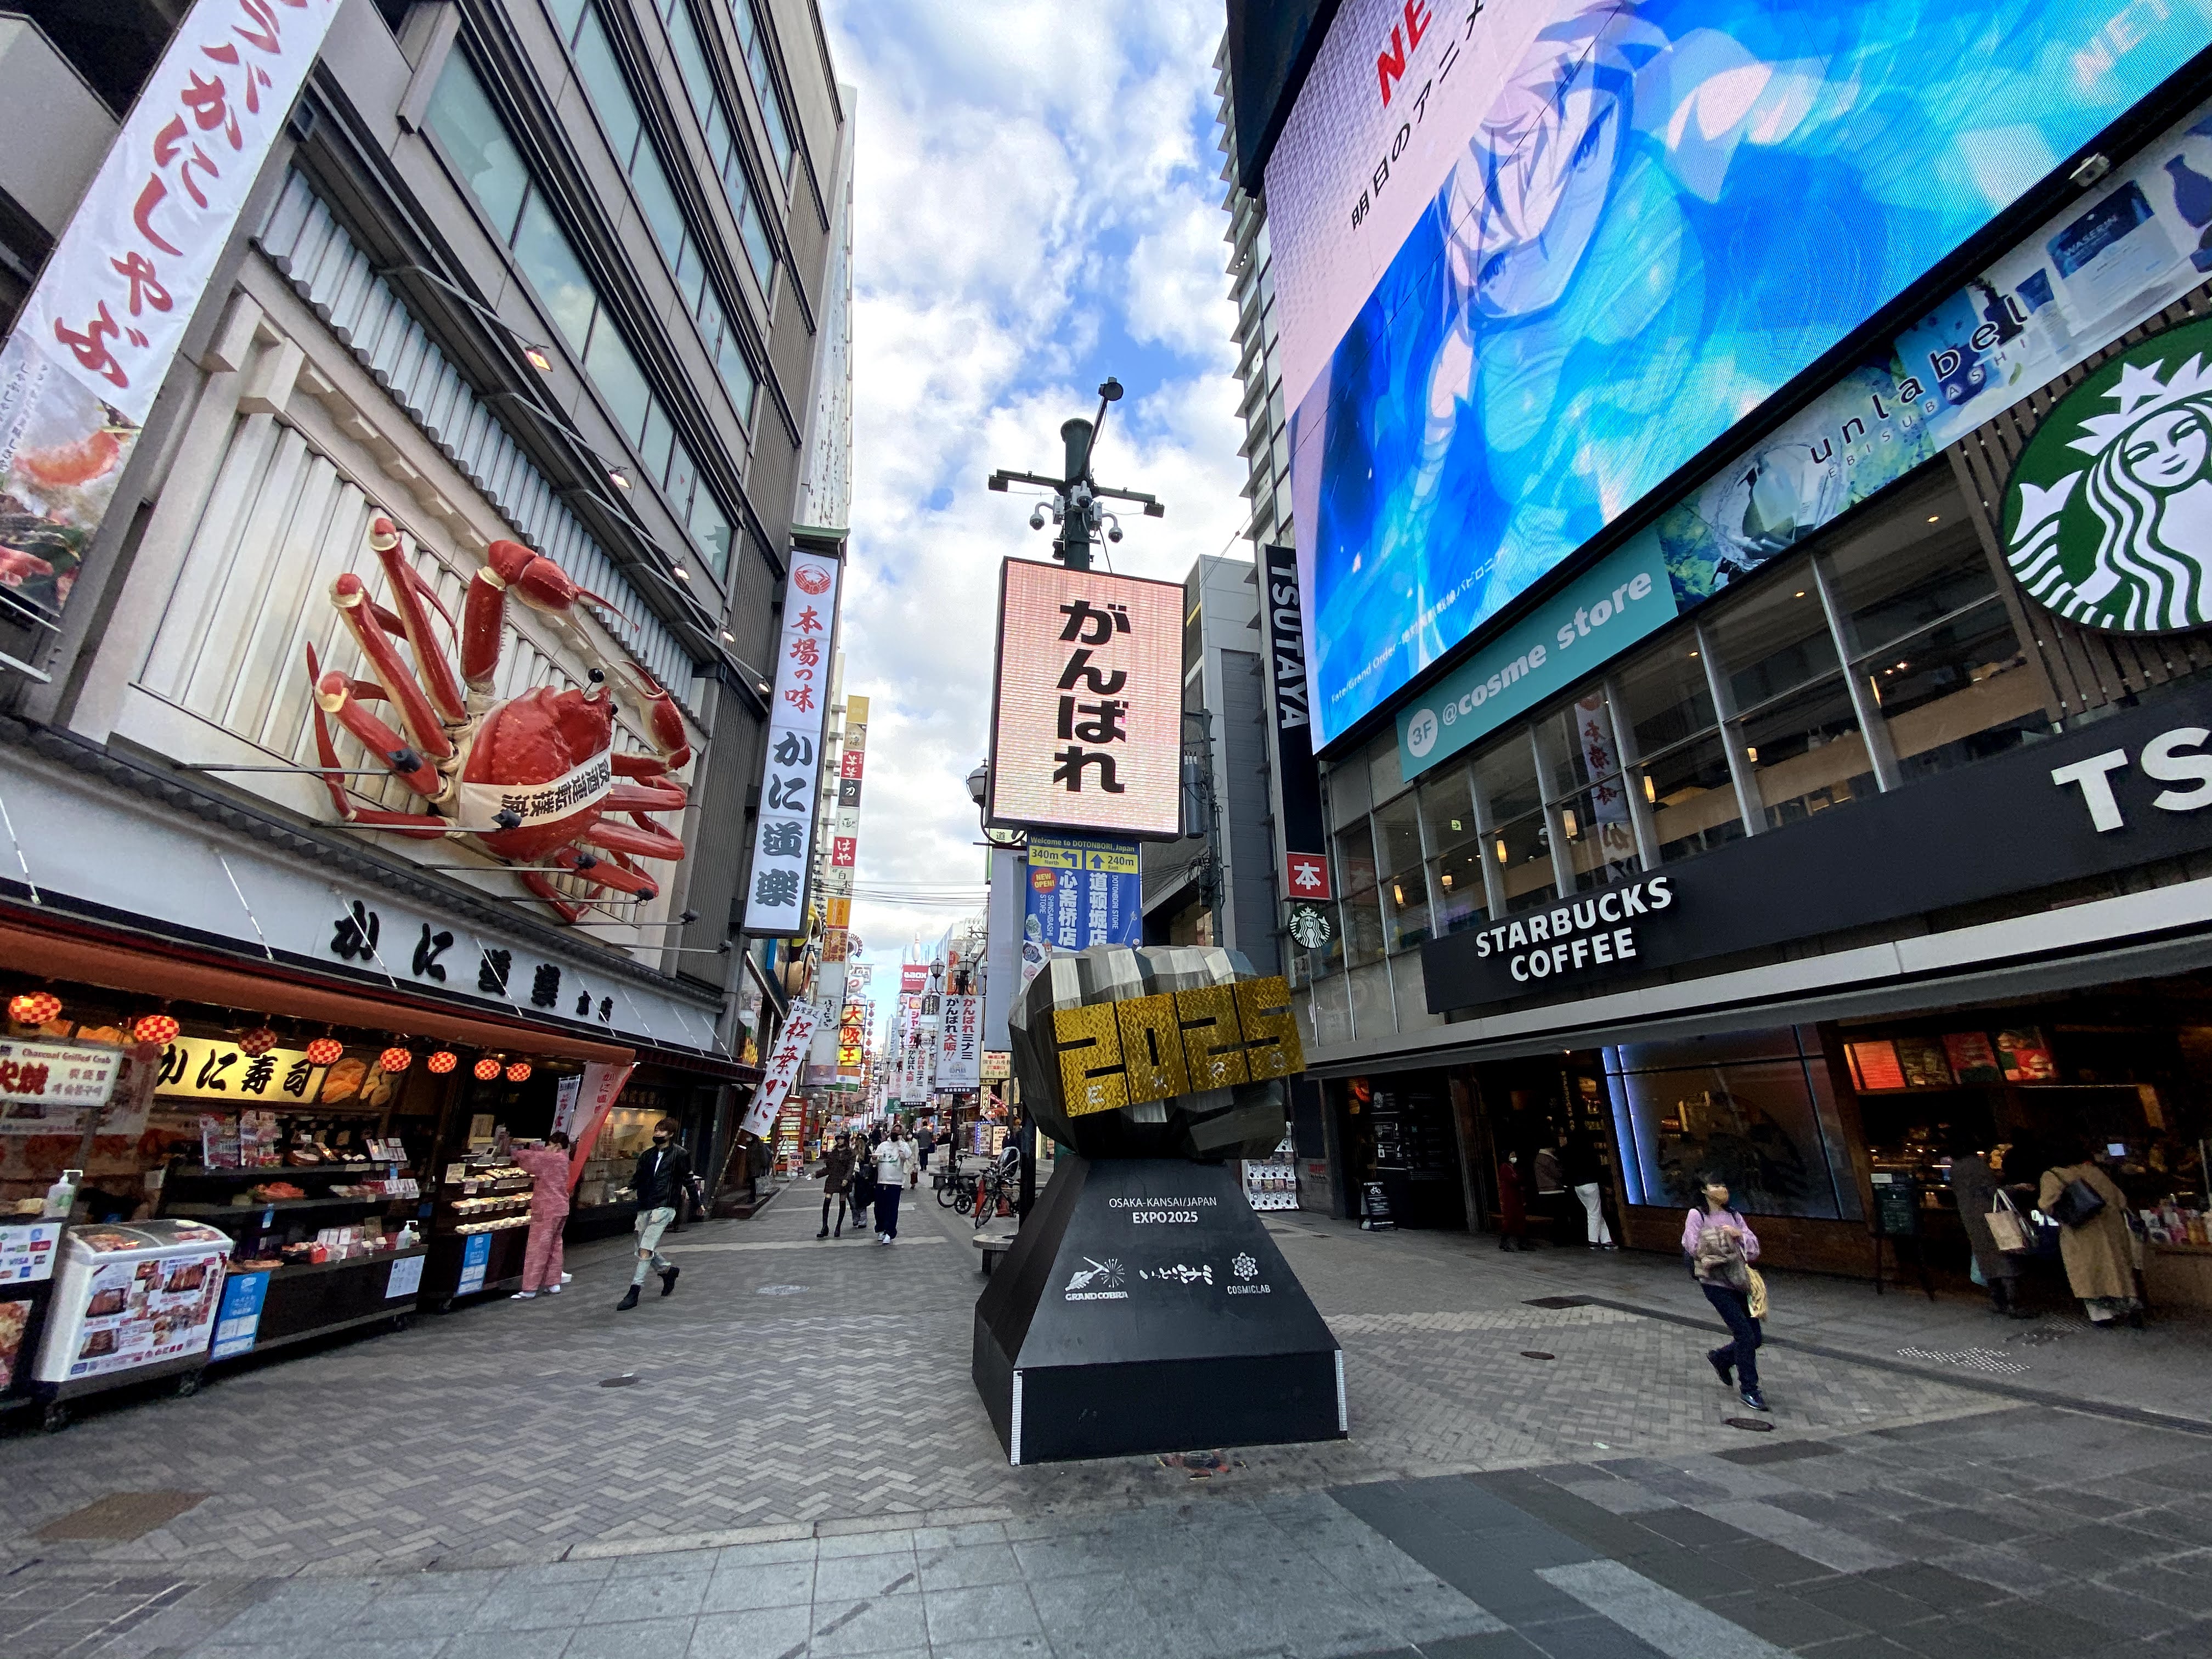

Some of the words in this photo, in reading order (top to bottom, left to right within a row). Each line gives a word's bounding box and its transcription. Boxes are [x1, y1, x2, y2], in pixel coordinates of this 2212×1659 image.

[1810, 295, 2028, 464] unlabel
[1829, 338, 2027, 479] EBISUBASHI
[785, 605, 823, 713] 本場の味
[1271, 563, 1309, 729] TSUTAYA
[1412, 720, 1432, 746] 3F
[1442, 644, 1547, 726] @cosme
[1557, 572, 1652, 651] store
[1053, 600, 1131, 794] がんばれ
[2051, 727, 2212, 832] TS
[1031, 837, 1062, 847] Welcome
[1063, 837, 1071, 847] to
[1115, 844, 1135, 854] Japan
[1031, 849, 1059, 860] 340m
[1108, 855, 1135, 866] 240m
[1034, 878, 1055, 889] OPEN!
[1035, 873, 1052, 881] NEW
[1294, 862, 1321, 890] 本
[1047, 895, 1055, 937] SHINSAIBASHI
[1476, 877, 1672, 958] STARBUCKS
[1511, 927, 1637, 982] COFFEE
[1053, 975, 1306, 1118] 2025
[1109, 1197, 1217, 1209] OSAKA-KANSAI/JAPAN
[1227, 1284, 1271, 1295] COSMICLAB
